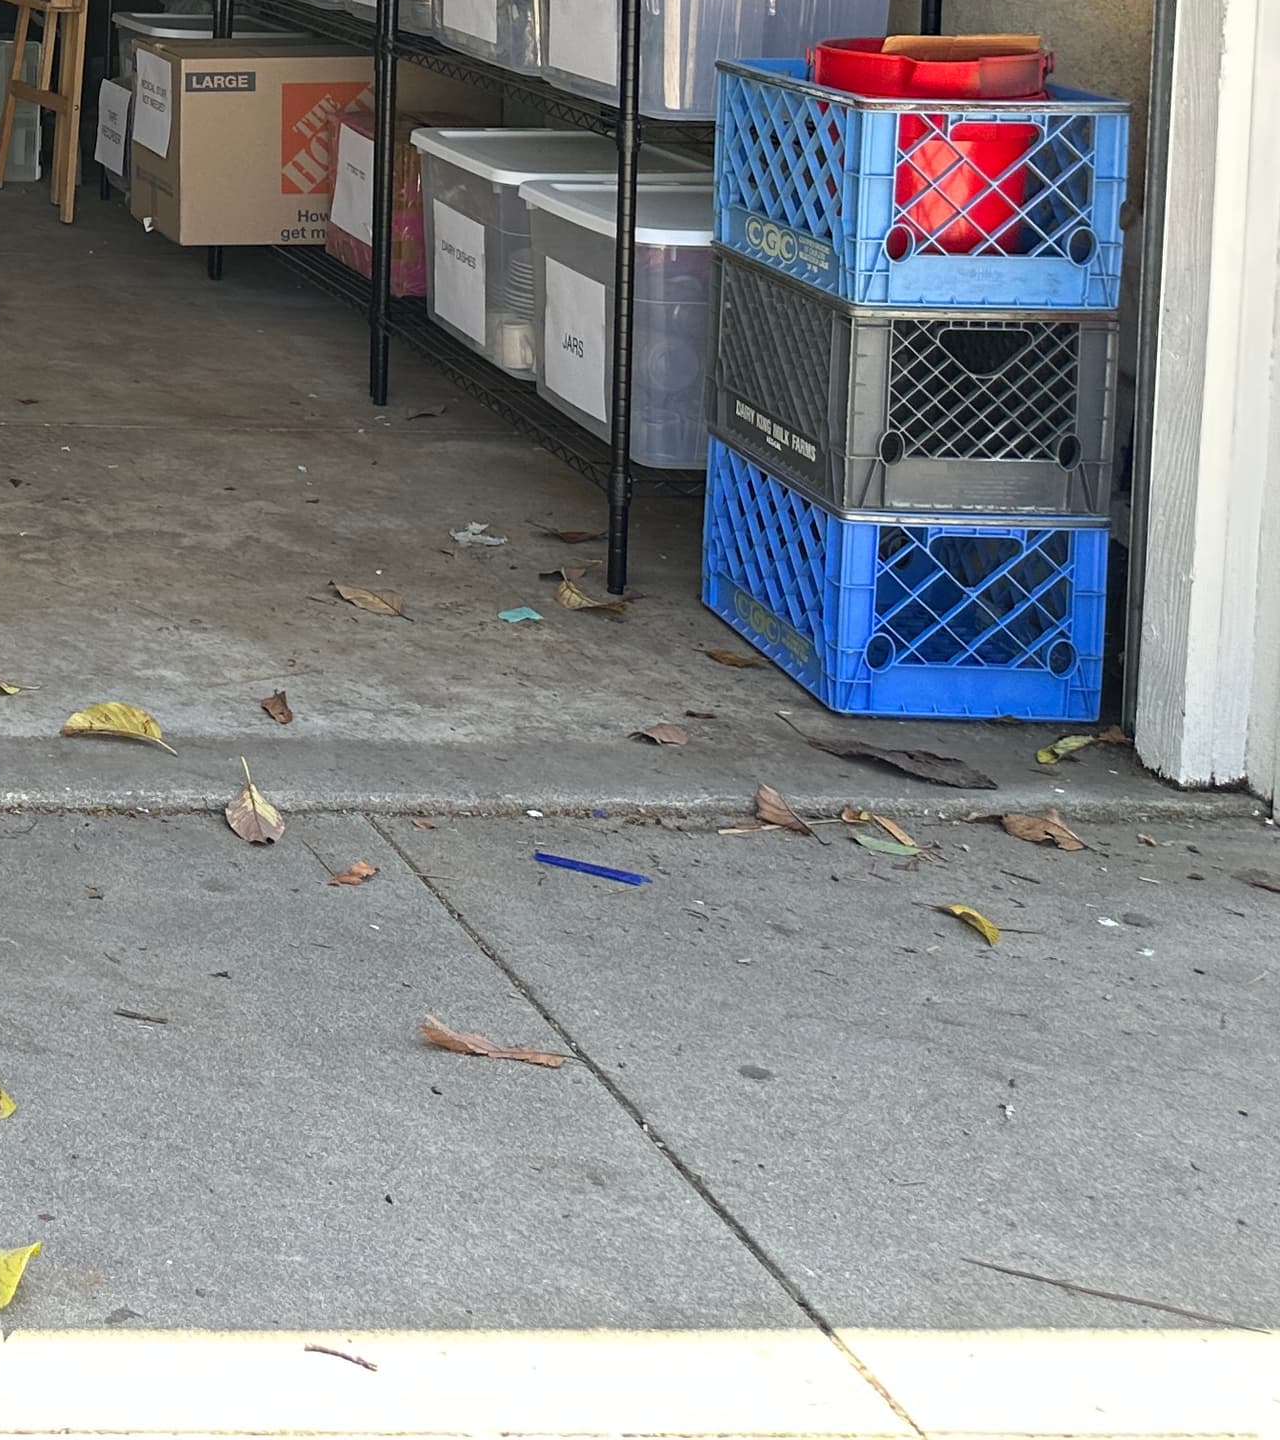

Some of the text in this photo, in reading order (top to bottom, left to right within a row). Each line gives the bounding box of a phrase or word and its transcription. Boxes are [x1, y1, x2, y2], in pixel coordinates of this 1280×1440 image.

[192, 76, 249, 89] LARGE
[292, 94, 341, 138] THE
[280, 227, 306, 242] get
[746, 217, 797, 263] CGC
[456, 248, 477, 269] DISHES
[562, 332, 584, 358] JARS
[735, 399, 755, 425] DAIRY
[756, 412, 772, 436] KING
[772, 422, 790, 447] MILK
[791, 433, 816, 462] FARMS
